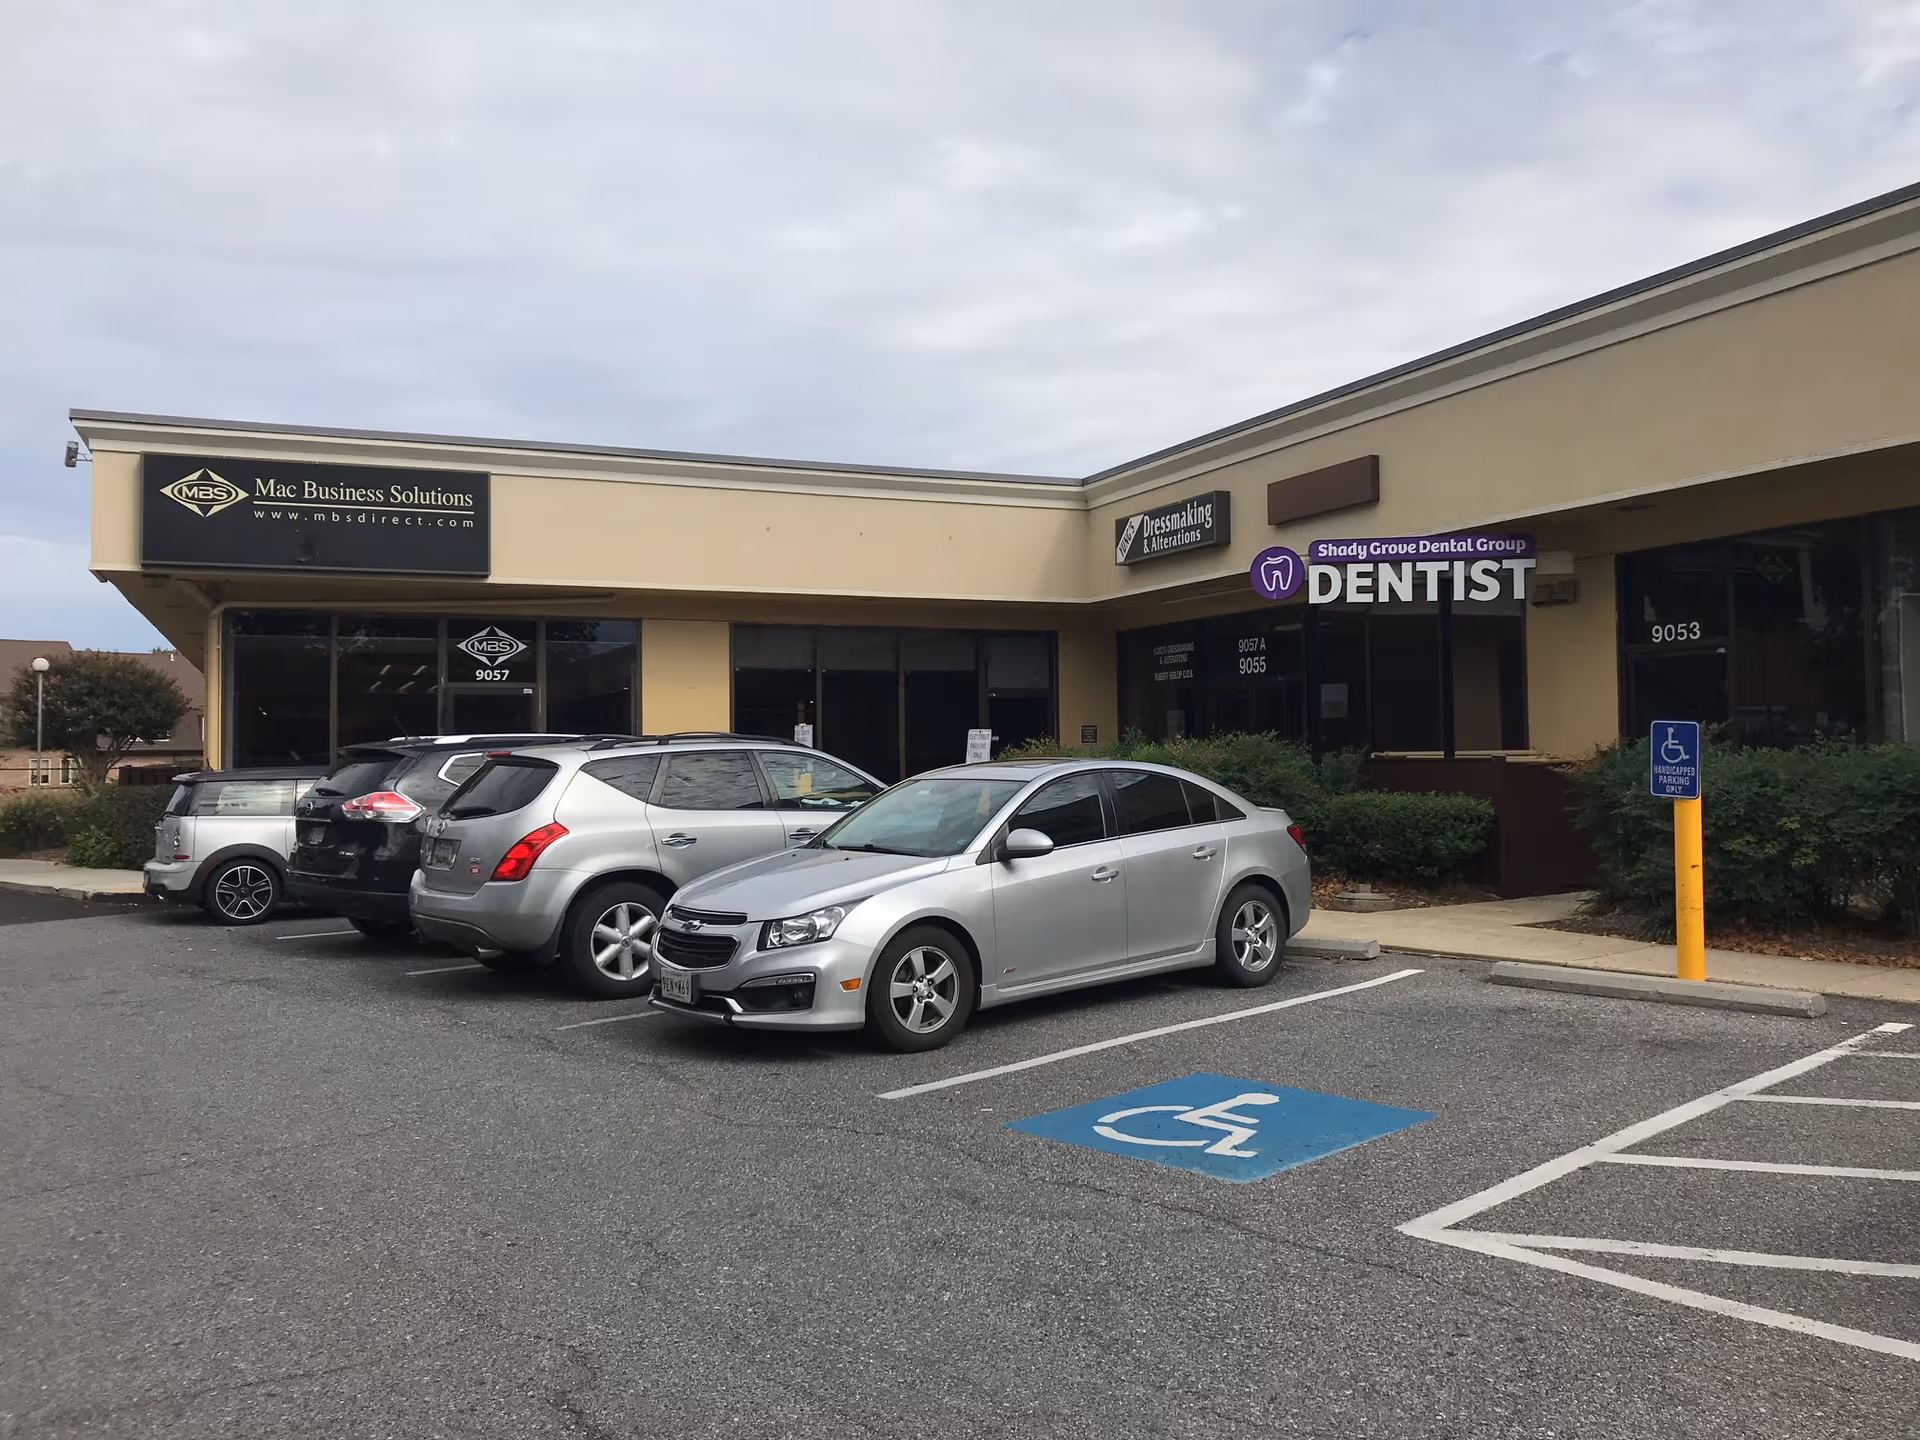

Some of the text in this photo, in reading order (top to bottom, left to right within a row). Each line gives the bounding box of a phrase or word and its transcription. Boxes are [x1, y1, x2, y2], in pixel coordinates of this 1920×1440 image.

[181, 486, 228, 500] MBS
[254, 477, 473, 507] Mac Business Solutions
[253, 510, 474, 528] www.mbsdirect.com
[1143, 500, 1212, 538] Dressmaking
[1143, 529, 1201, 554] & Alterations
[1317, 538, 1527, 560] Shady Grove Dental Group
[1308, 558, 1537, 605] DENTIST
[1652, 621, 1701, 643] 9053
[474, 640, 511, 652] MBS
[1238, 637, 1266, 653] 9057 A
[1239, 656, 1267, 675] 9055
[475, 669, 510, 681] 9057
[1653, 765, 1696, 776] HANDICAPPED
[1658, 775, 1690, 786] PARKING
[1665, 784, 1683, 794] ONLY
